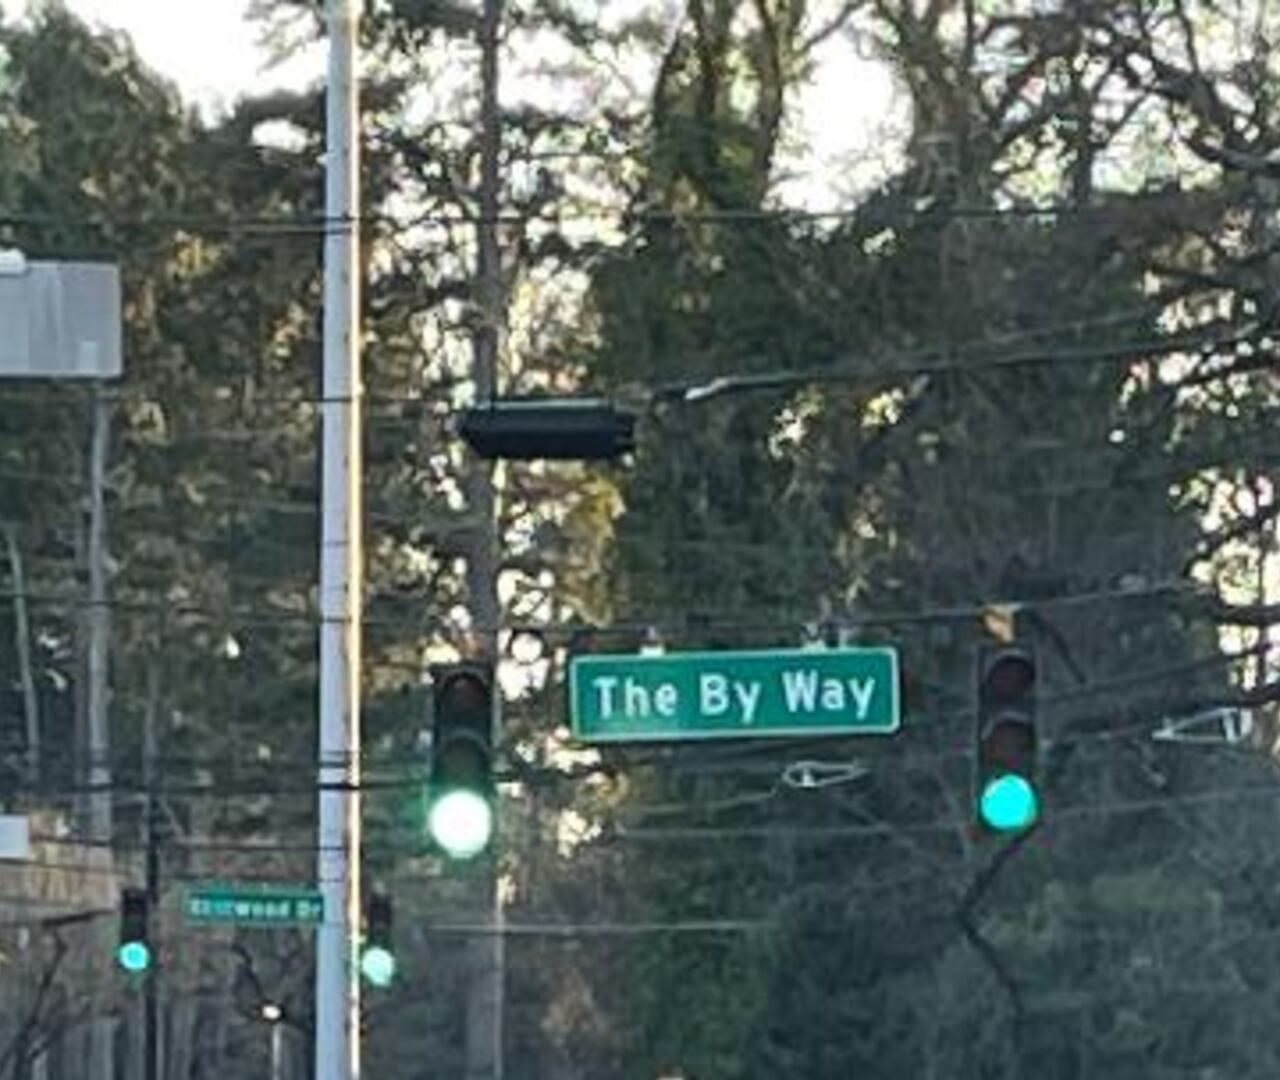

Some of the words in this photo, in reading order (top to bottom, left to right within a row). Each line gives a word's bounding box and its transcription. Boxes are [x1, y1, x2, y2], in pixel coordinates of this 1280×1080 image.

[592, 676, 679, 720] The
[699, 673, 760, 723] By
[782, 669, 875, 720] Way
